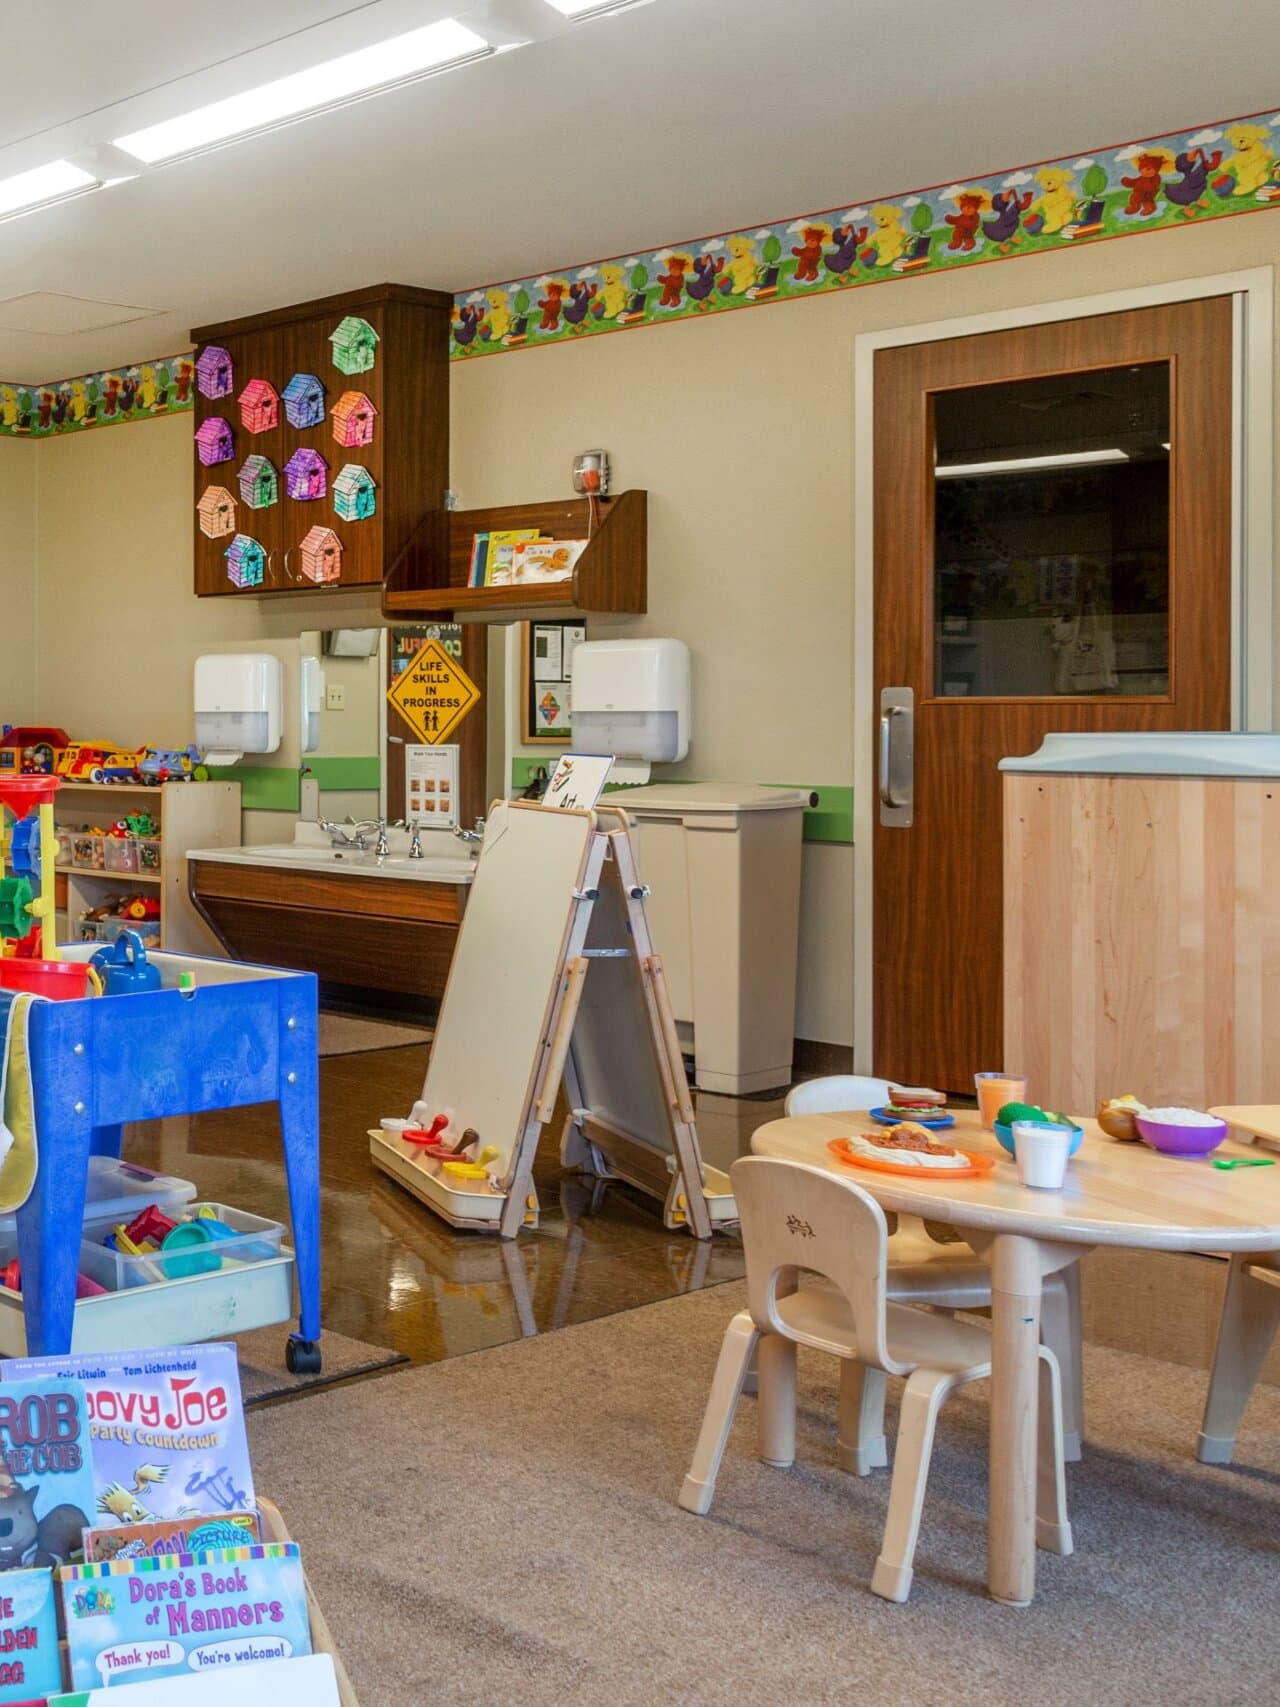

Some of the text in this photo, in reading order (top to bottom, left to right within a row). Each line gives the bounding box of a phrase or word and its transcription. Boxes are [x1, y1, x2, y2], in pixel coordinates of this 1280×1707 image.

[419, 661, 442, 671] LIFE
[412, 673, 450, 683] SKILLS
[425, 686, 436, 695] IN
[403, 698, 460, 707] PROGRESS
[560, 793, 578, 808] Art
[77, 1367, 106, 1380] Litwin
[123, 1365, 142, 1376] Tom
[144, 1360, 197, 1374] Lichtenheld
[164, 1377, 228, 1430] Joe
[91, 1422, 220, 1451] Party Countdown
[32, 1443, 82, 1474] COB
[190, 1529, 249, 1550] PICTURE
[128, 1567, 248, 1604] Dora's Book
[145, 1600, 285, 1636] of Manners
[104, 1643, 171, 1669] Thank you!
[197, 1642, 285, 1666] You're welcome!
